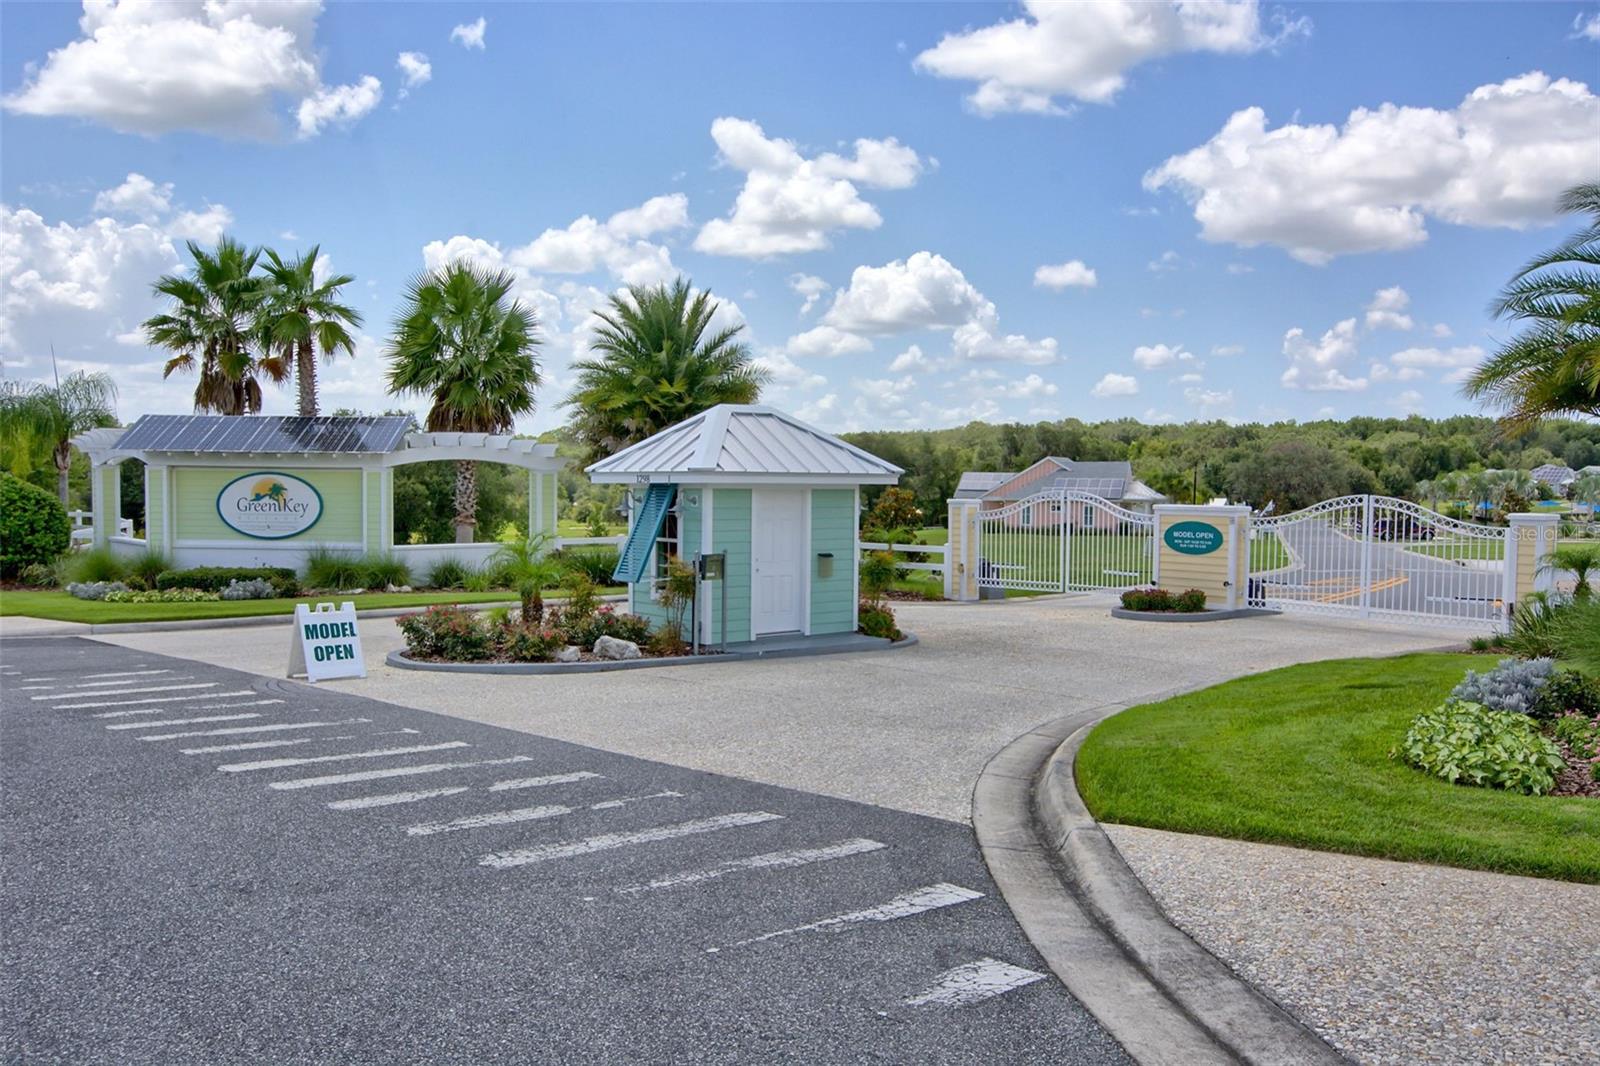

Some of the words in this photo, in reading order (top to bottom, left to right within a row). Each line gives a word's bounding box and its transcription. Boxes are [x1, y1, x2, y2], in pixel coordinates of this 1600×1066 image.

[1173, 531, 1195, 539] MODEL
[304, 622, 357, 640] MODEL
[314, 644, 354, 662] OPEN
